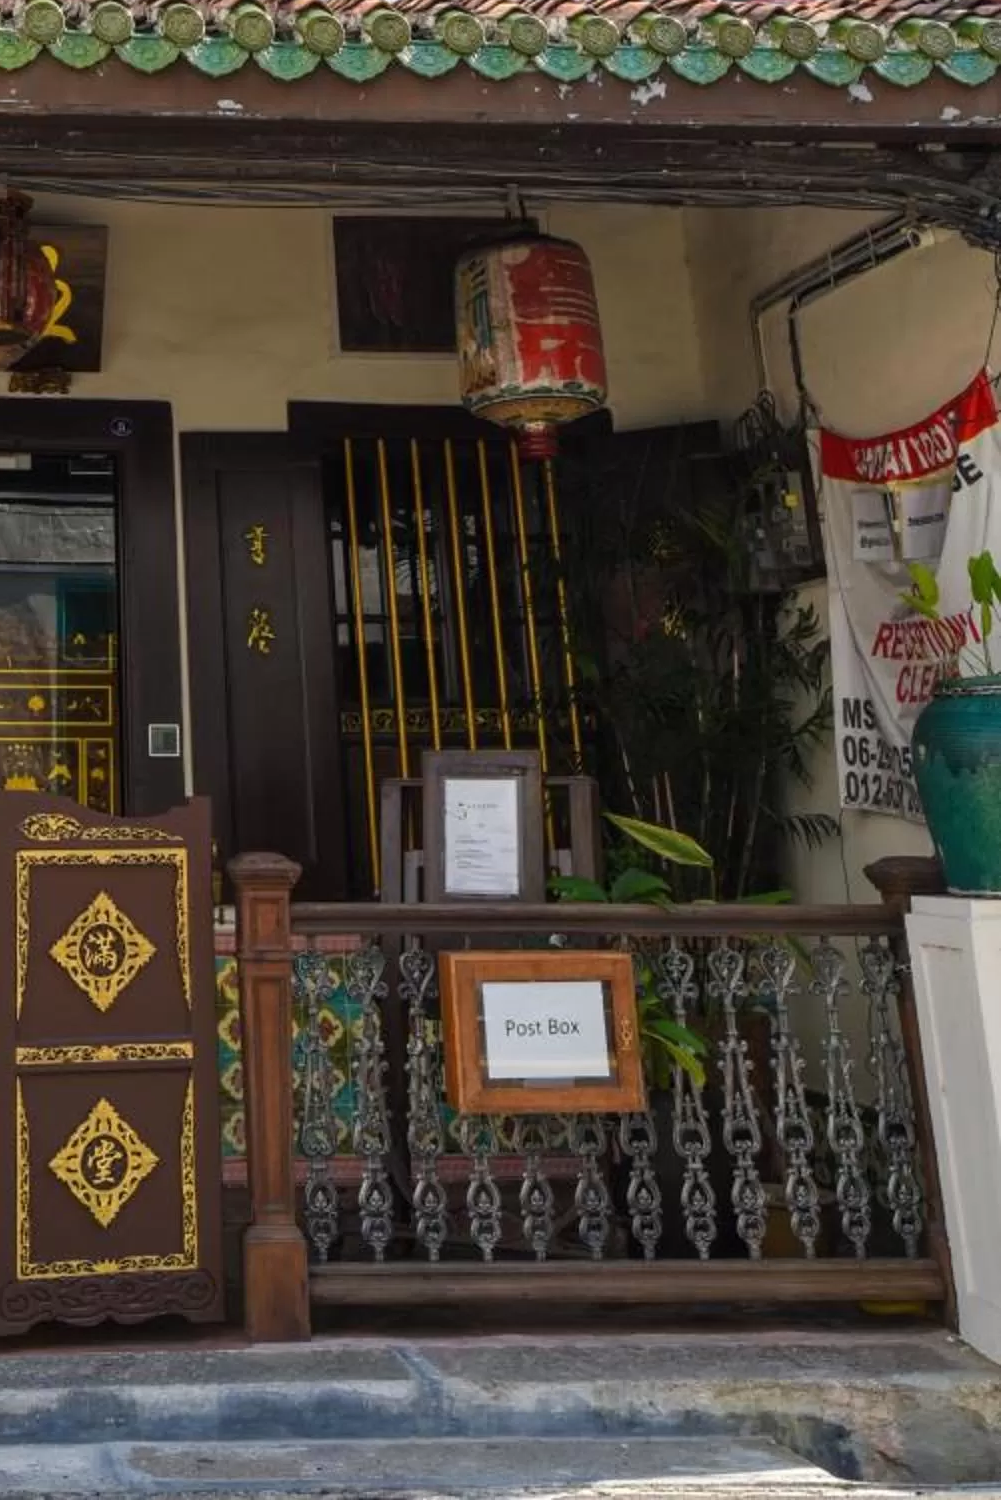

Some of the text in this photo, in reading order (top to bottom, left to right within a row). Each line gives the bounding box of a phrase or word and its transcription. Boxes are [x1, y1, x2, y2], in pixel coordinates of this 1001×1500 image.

[505, 1018, 580, 1037] Post Box
[86, 1139, 124, 1186] 堂
